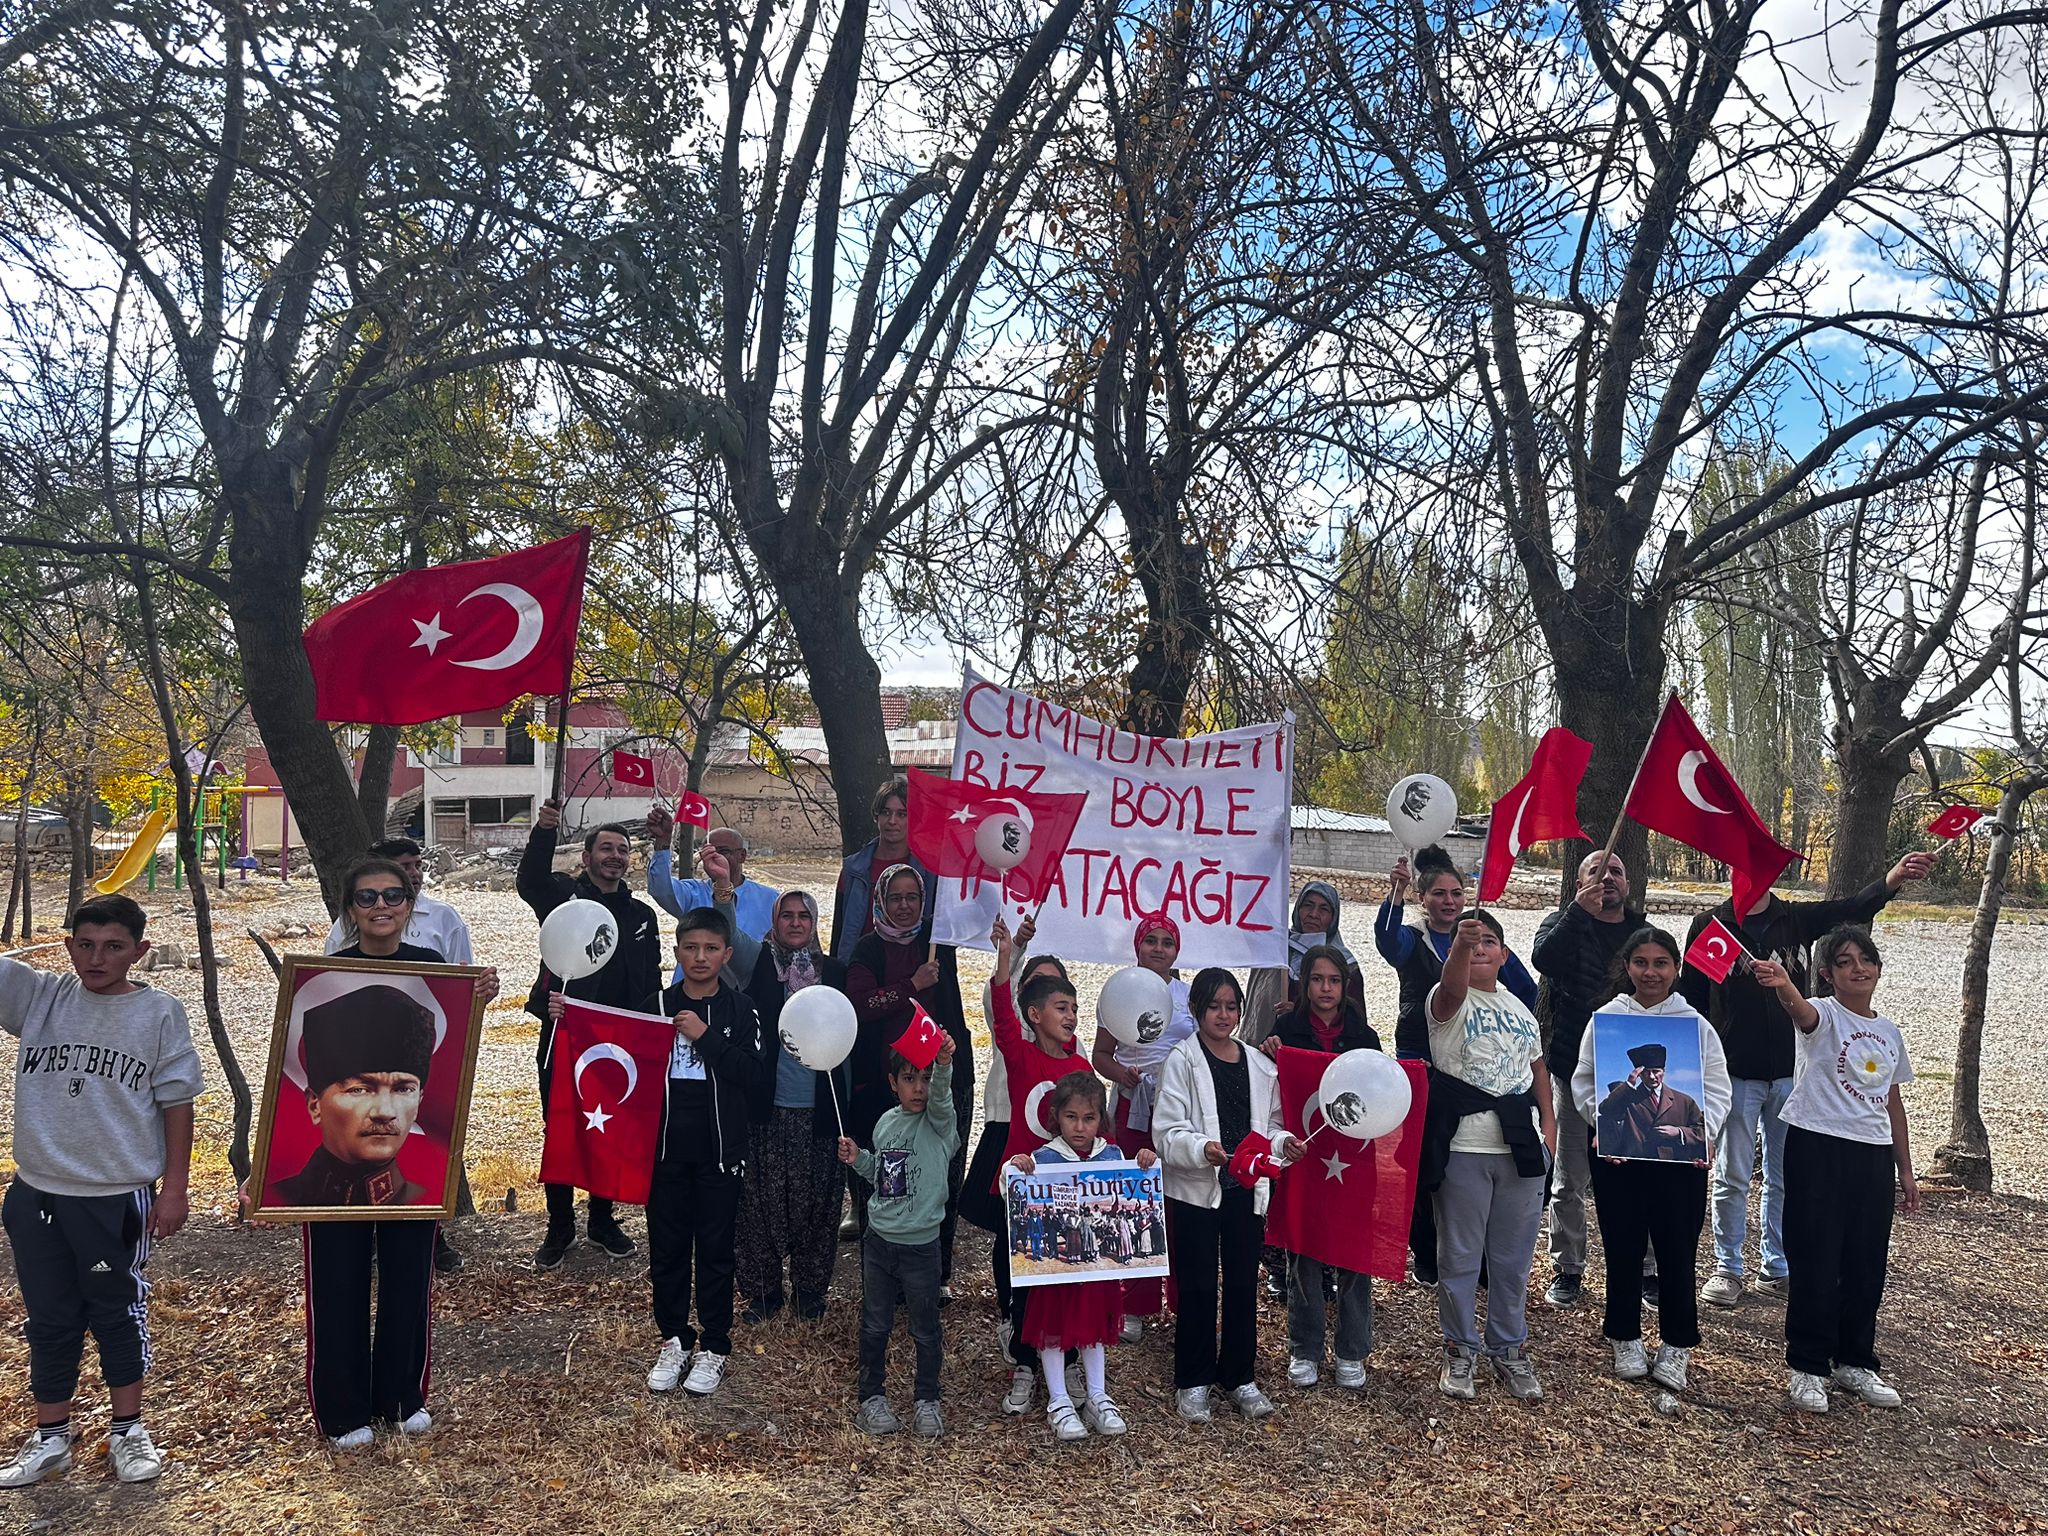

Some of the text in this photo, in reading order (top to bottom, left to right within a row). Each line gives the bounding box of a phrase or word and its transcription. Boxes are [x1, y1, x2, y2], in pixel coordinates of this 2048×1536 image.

[1110, 776, 1258, 836] BÖYLE
[1837, 1040, 1851, 1074] FLOR
[1850, 1031, 1887, 1047] BONJOUR
[21, 1043, 147, 1091] WRSTBHVR
